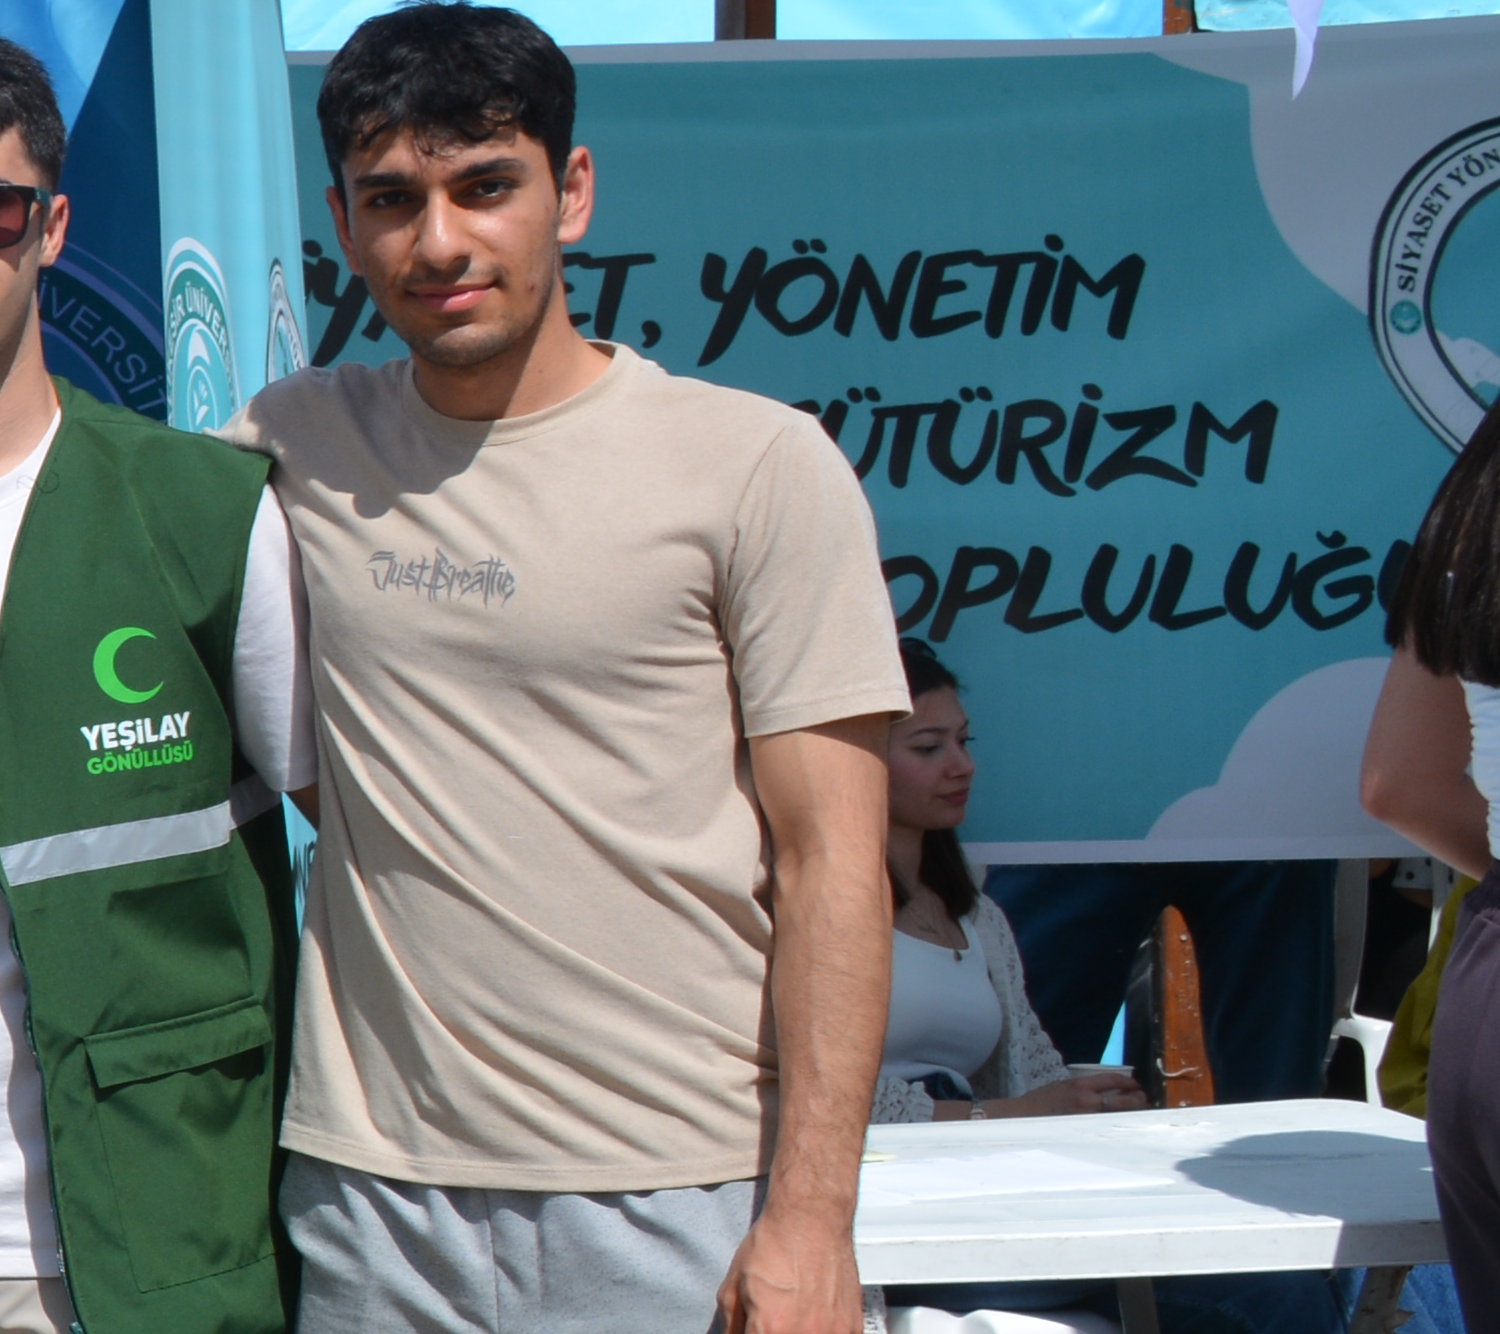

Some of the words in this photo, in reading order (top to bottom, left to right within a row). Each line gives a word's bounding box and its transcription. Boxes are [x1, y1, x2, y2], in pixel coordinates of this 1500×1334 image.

[1394, 182, 1452, 293] SİYASET
[697, 232, 1148, 367] YÖNETİM
[788, 382, 1280, 497] ÜTÜRİZM
[80, 711, 191, 752] YEŞİLAY
[86, 739, 194, 775] GÖNÜLLÜSÜ
